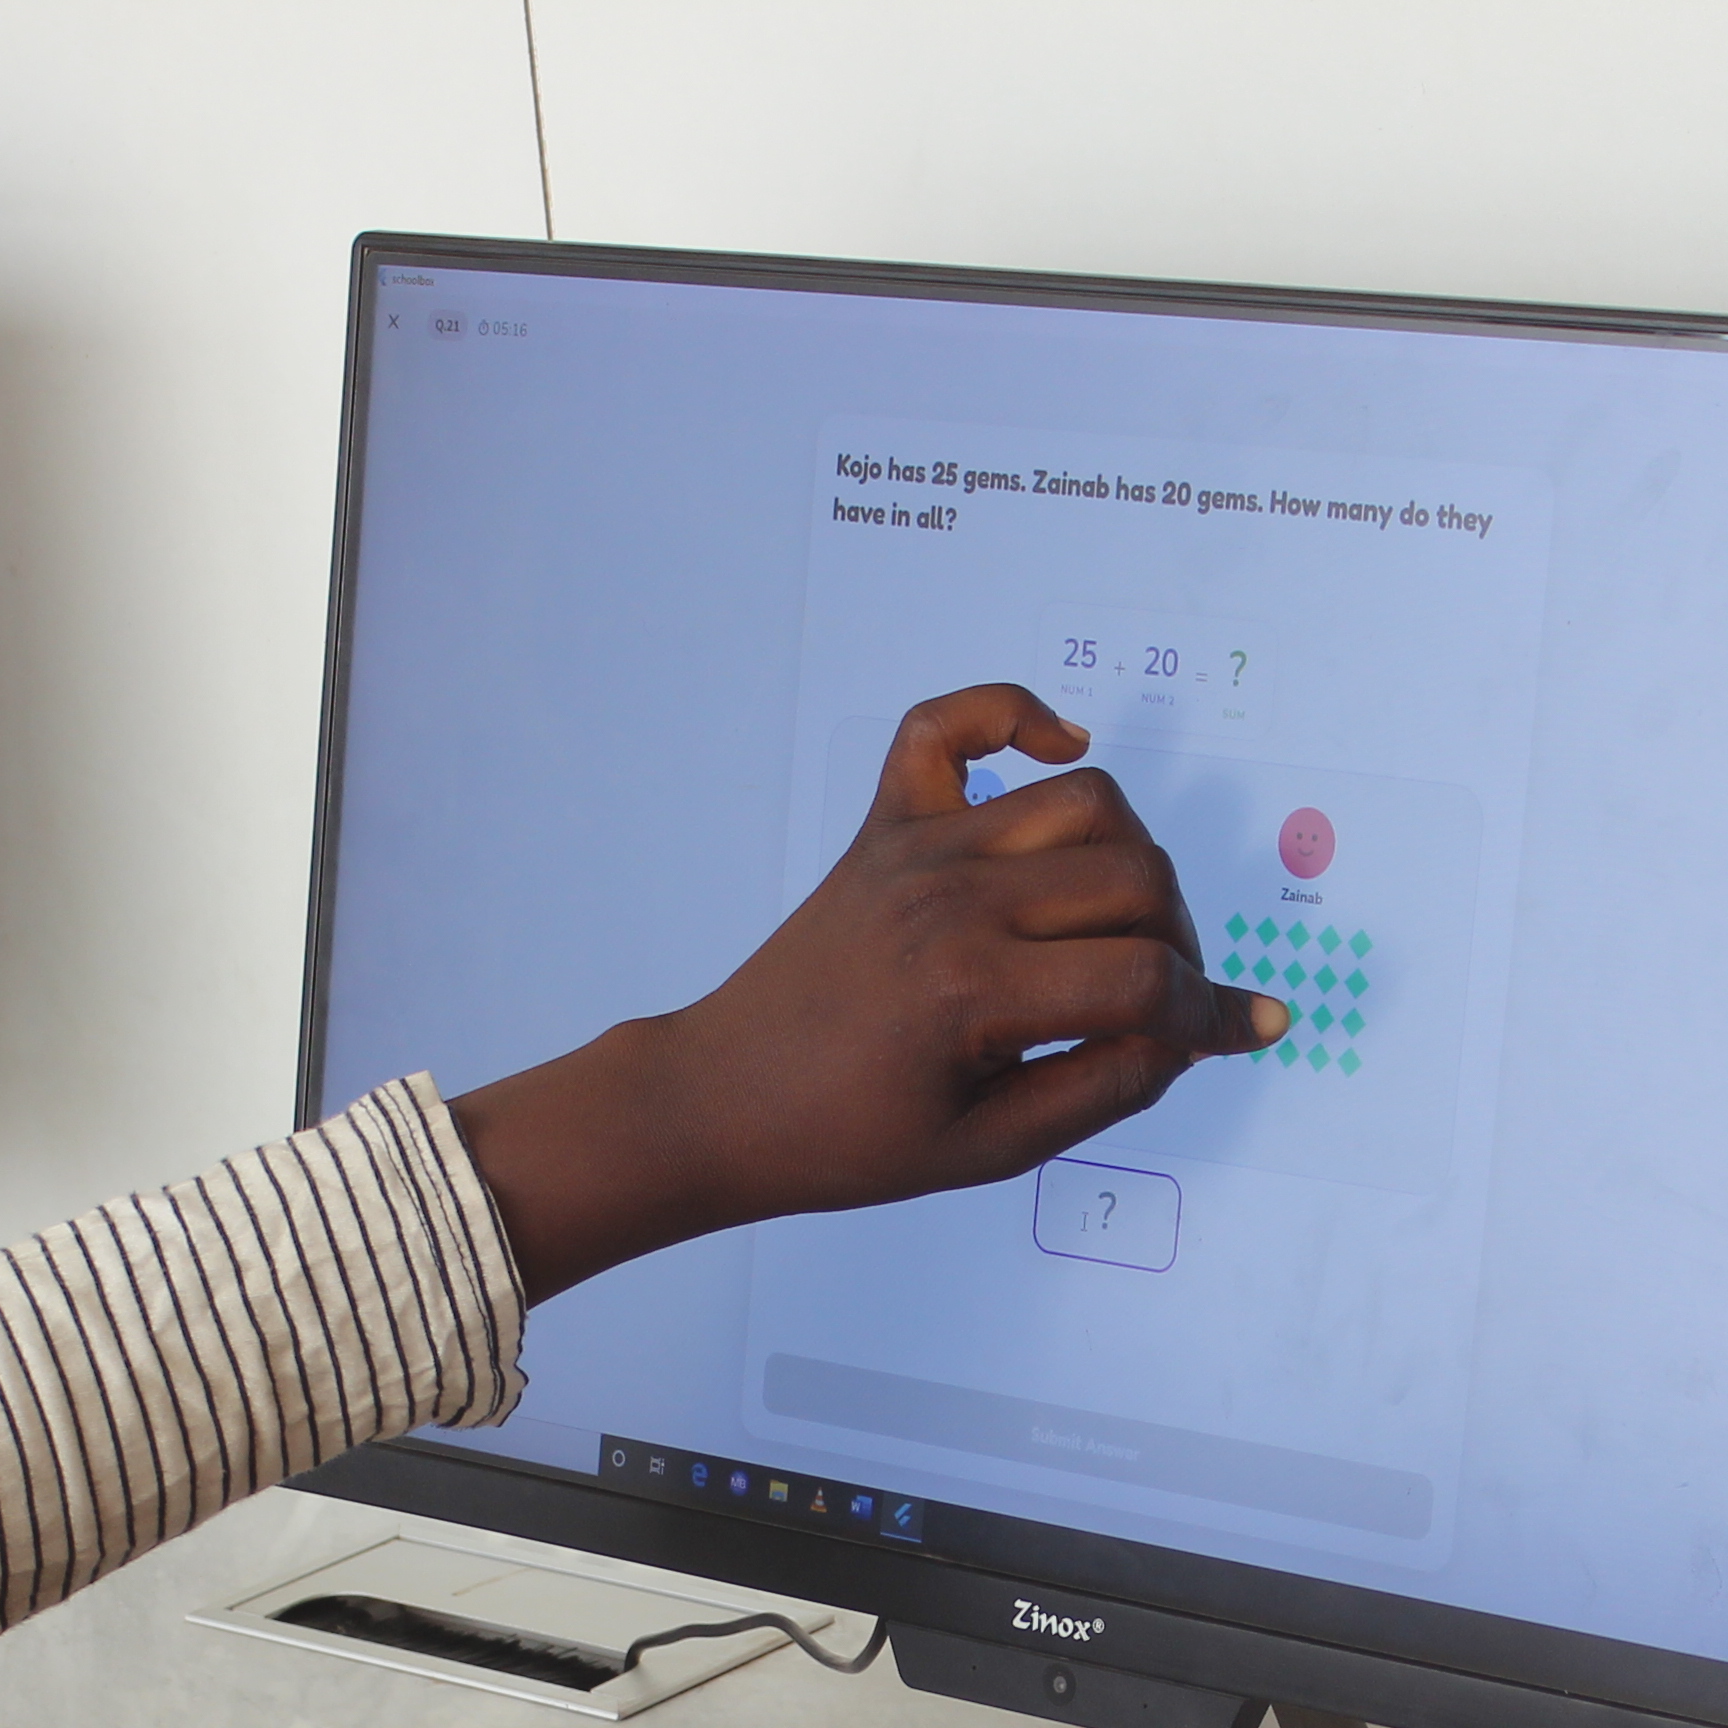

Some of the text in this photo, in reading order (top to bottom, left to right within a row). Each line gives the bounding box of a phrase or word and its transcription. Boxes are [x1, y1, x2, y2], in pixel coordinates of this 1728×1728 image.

[392, 274, 435, 287] schoolbox
[435, 319, 460, 333] Q.21
[493, 321, 527, 337] 05:16
[836, 453, 1493, 540] Kojo has 25 gems. Zainab has 20 gems. How many do they
[833, 497, 958, 531] have in all?
[1063, 638, 1248, 687] 25 + 20 = ?
[1061, 684, 1094, 697] NUM 1
[1141, 693, 1175, 706] NUM 2
[1222, 709, 1246, 720] SUM
[1280, 887, 1324, 905] Zainab
[1098, 1191, 1117, 1231] ?
[1031, 1426, 1141, 1462] Submit Answer
